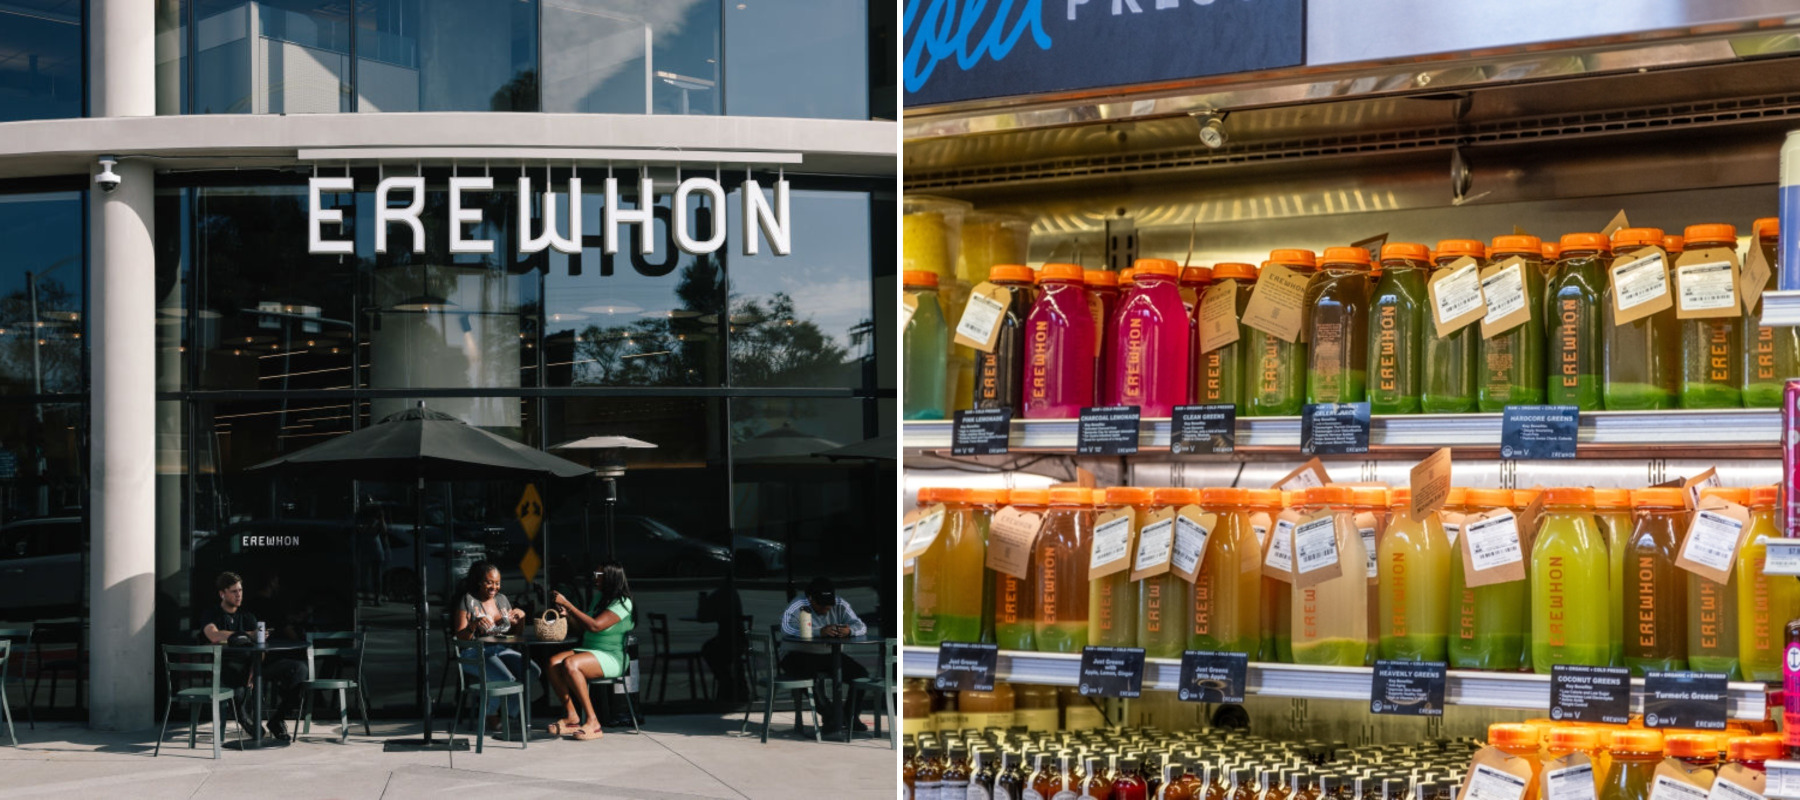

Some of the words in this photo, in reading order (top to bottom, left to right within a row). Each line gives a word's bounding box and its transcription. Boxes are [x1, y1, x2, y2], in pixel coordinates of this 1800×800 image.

[308, 176, 790, 256] EREWHON
[1033, 320, 1048, 398] EREWHON
[1127, 318, 1142, 397] EREWHON
[1265, 334, 1278, 393] EREWH
[1381, 305, 1395, 390] EREWHON
[1563, 299, 1578, 387] EREWHON
[1711, 318, 1728, 380] EREW
[984, 354, 997, 398] EREW
[1208, 350, 1220, 399] EREW
[242, 535, 300, 546] EREWHON
[1006, 573, 1017, 624] EREW
[1044, 546, 1056, 624] EREWHON
[1101, 581, 1112, 630] EREW
[1148, 577, 1160, 632] EREW
[1305, 584, 1316, 638] EREW
[1393, 551, 1406, 637] EREWHON
[1461, 585, 1474, 640] EREW
[1549, 556, 1565, 647] EREWHON
[1640, 556, 1654, 647] EREWHON
[1701, 577, 1716, 648] EREWH
[1593, 677, 1620, 685] GREENS
[1655, 691, 1689, 699] Turmeric
[1691, 692, 1718, 700] Greens
